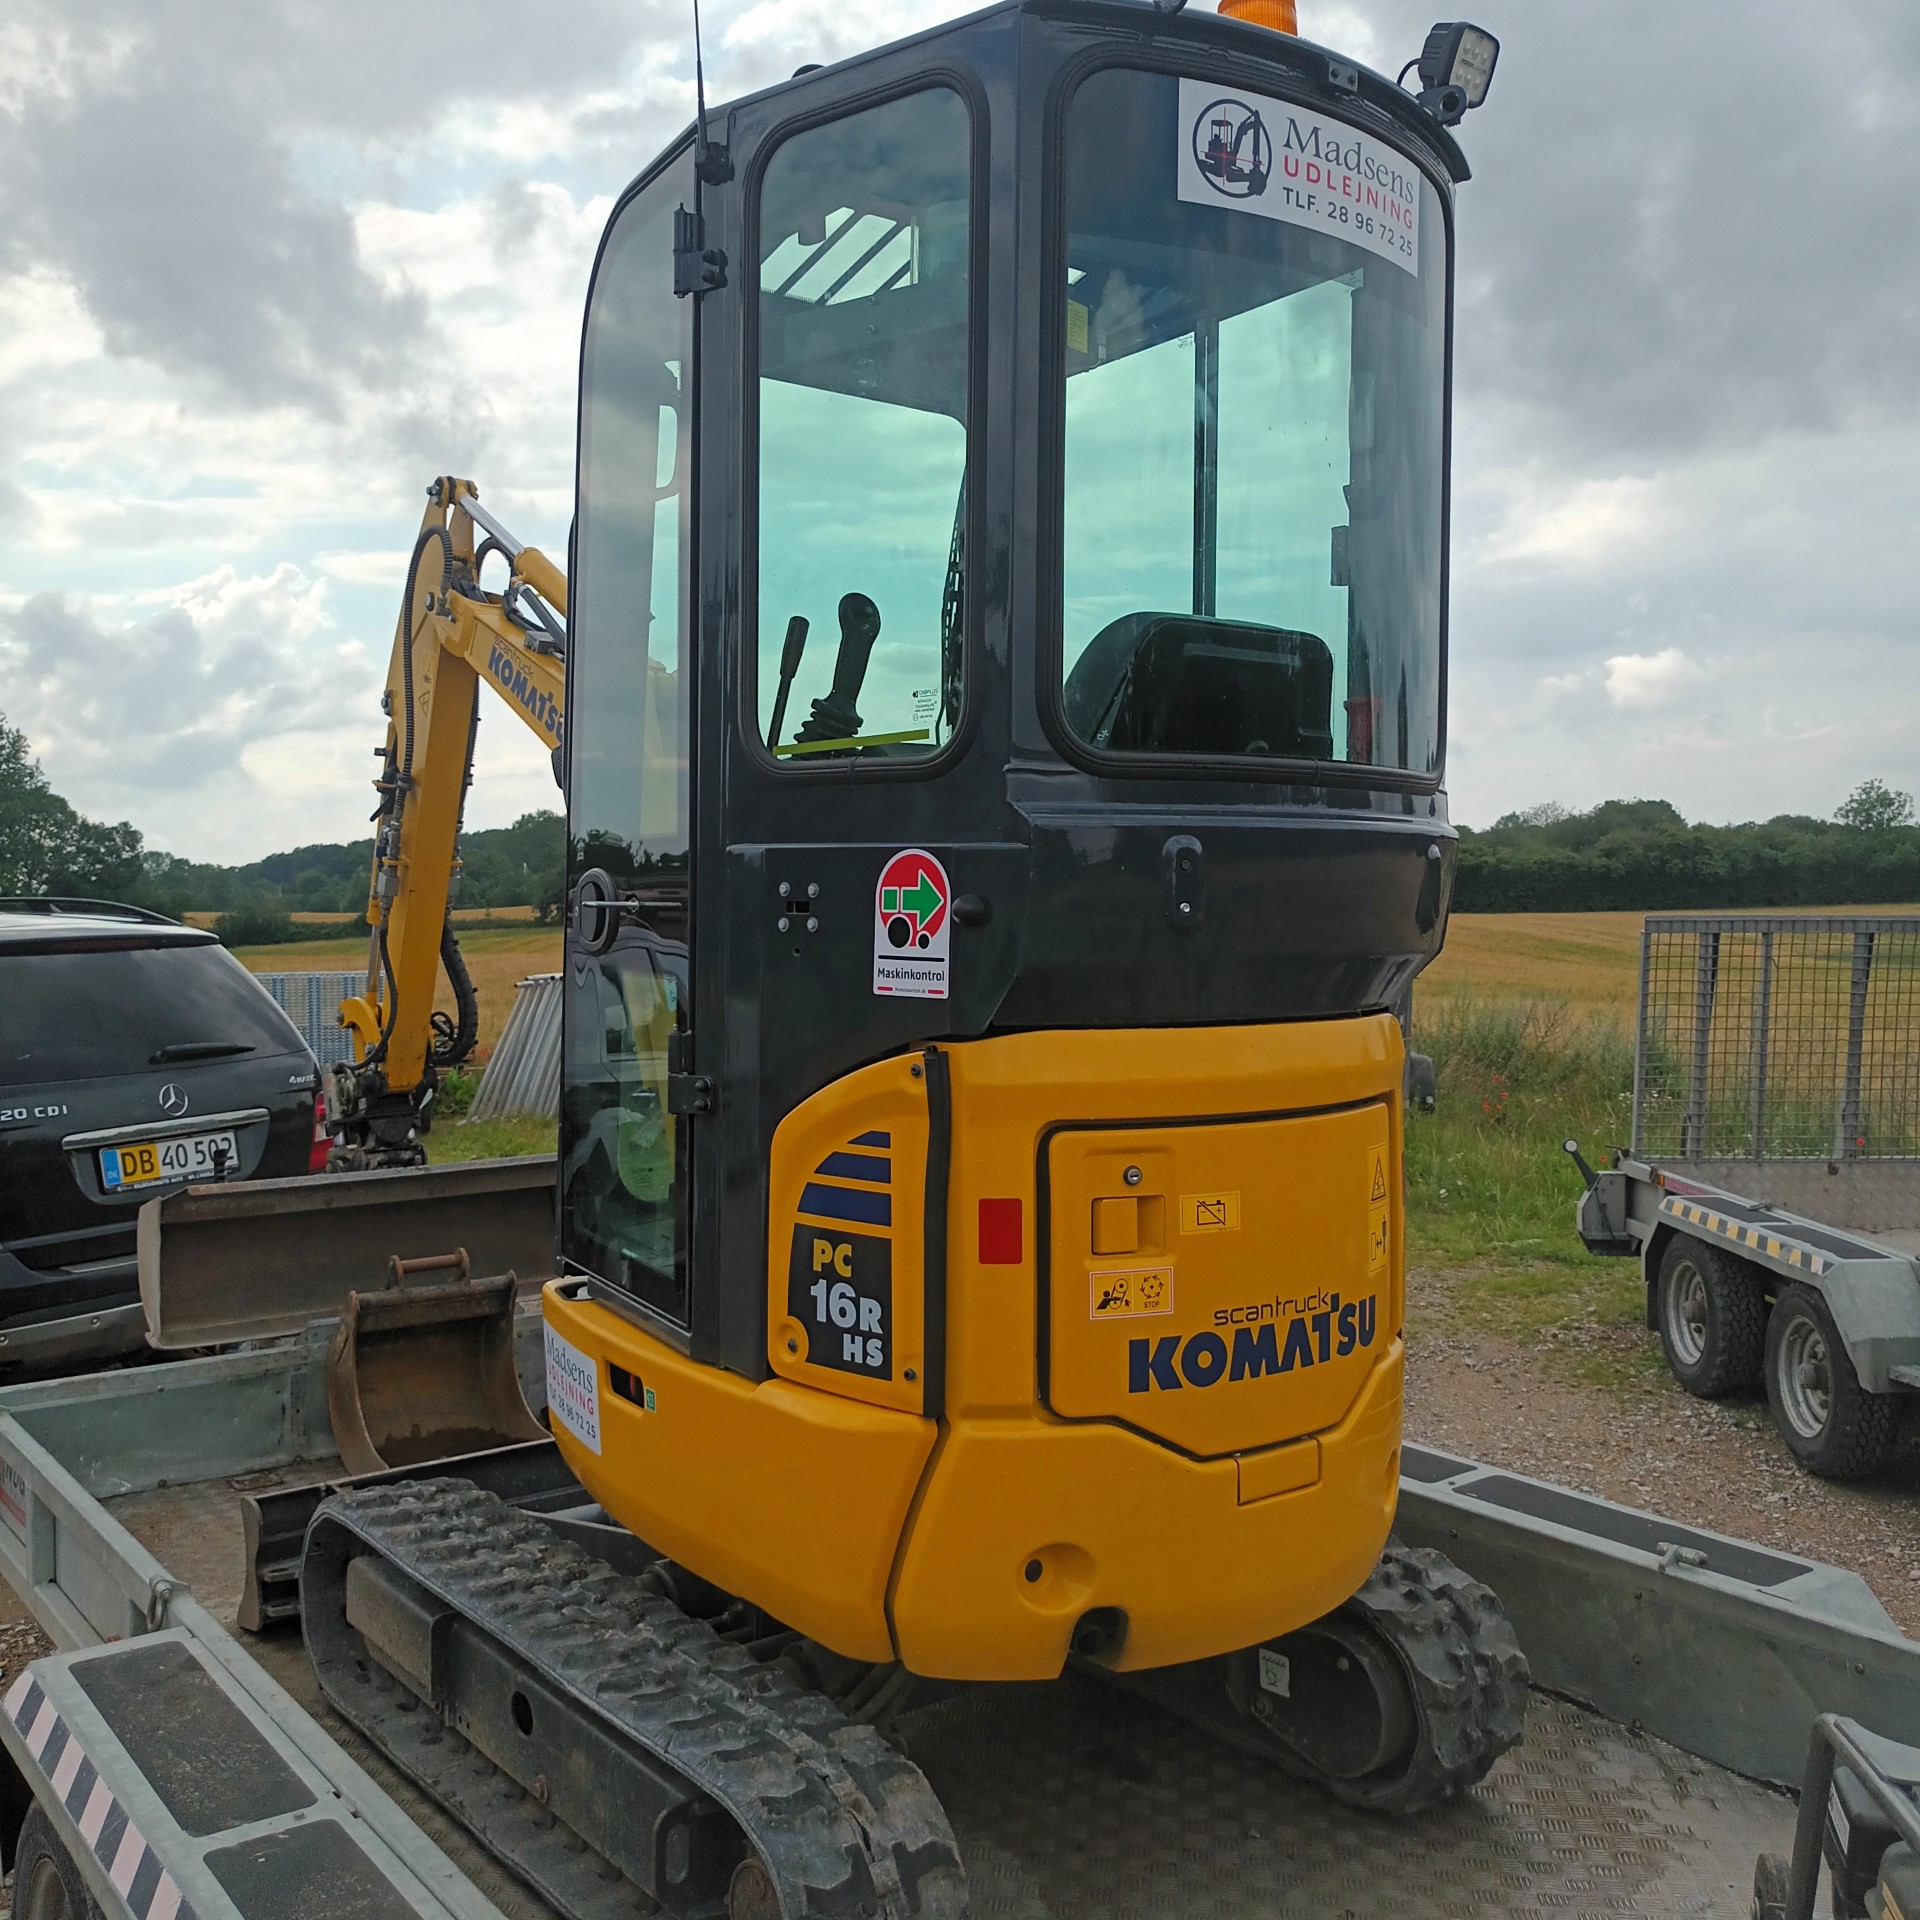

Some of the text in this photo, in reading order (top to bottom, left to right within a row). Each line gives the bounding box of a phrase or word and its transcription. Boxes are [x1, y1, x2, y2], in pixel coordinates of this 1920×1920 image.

[1282, 117, 1414, 205] Madsens
[1284, 154, 1413, 230] UDLEJNING
[1283, 186, 1413, 257] TLF. 28 96 72 25
[494, 635, 535, 680] scantruck
[877, 966, 945, 982] Maskinkontrol
[34, 1104, 68, 1118] CDI
[107, 1170, 119, 1180] DK
[121, 1136, 234, 1178] DB 40 502
[812, 1238, 853, 1278] PC
[810, 1278, 884, 1335] 16R
[1143, 1300, 1160, 1309] STOP
[1213, 1287, 1329, 1326] scantruck
[546, 1331, 593, 1393] Madsens
[842, 1333, 884, 1367] HS
[1128, 1292, 1377, 1393] KOMATSU
[575, 1411, 585, 1430] 72
[586, 1420, 596, 1439] 25
